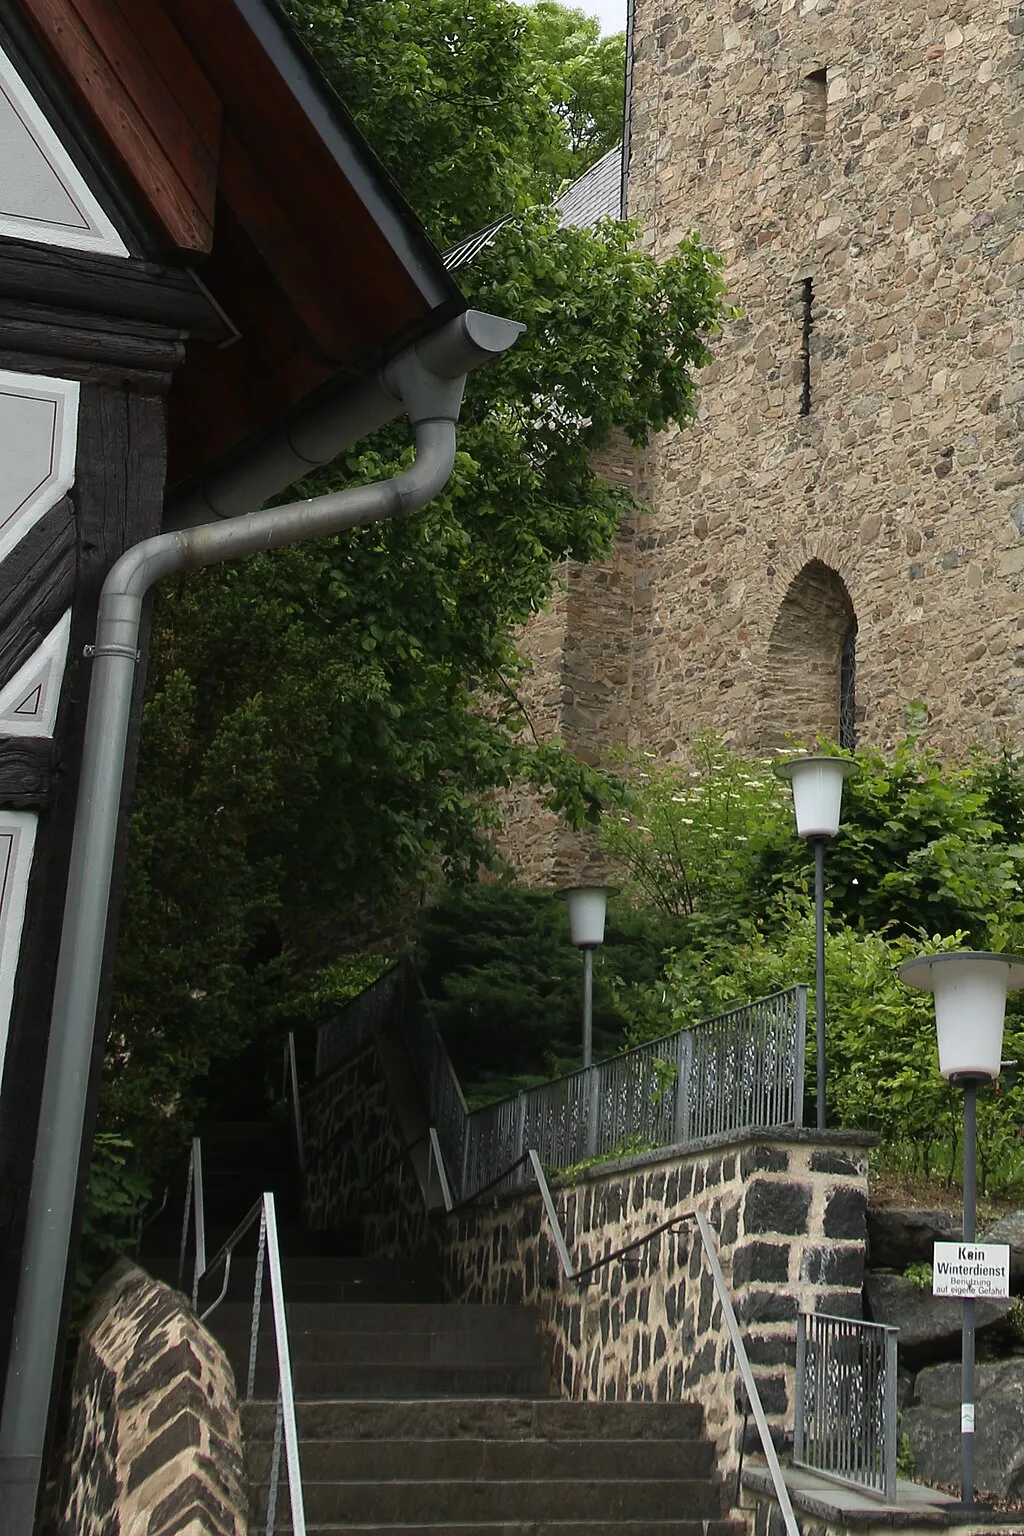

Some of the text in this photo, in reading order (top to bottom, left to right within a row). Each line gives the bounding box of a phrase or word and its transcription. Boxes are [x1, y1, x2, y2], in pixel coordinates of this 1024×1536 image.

[958, 1247, 985, 1261] Kein
[937, 1262, 1005, 1277] Winterdienst
[950, 1277, 991, 1288] Benutzung
[936, 1285, 948, 1293] auf
[950, 1286, 976, 1295] eigene
